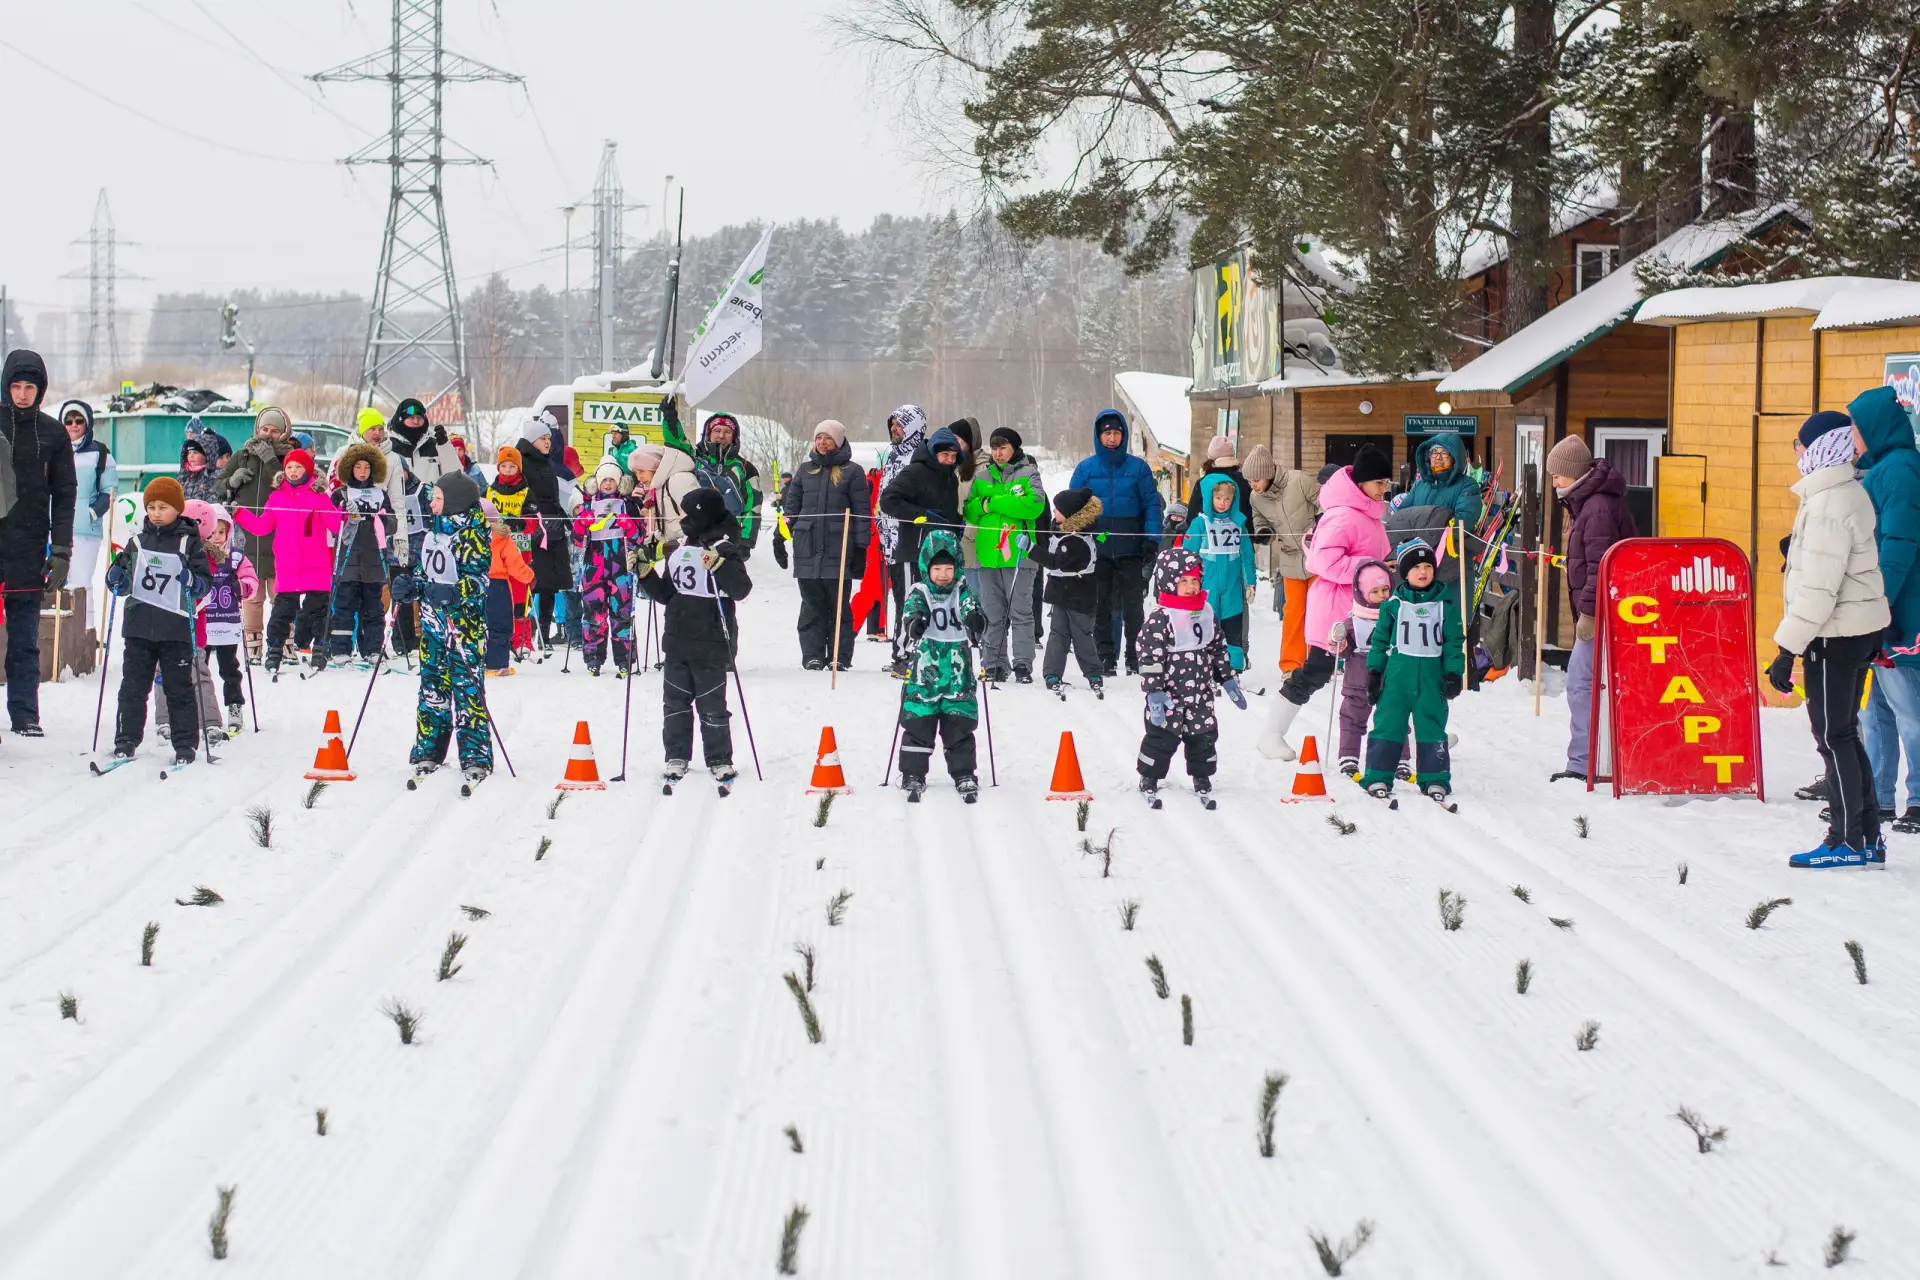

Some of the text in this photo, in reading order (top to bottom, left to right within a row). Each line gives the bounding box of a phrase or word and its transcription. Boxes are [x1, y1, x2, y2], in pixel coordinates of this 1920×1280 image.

[590, 404, 662, 423] ТУАЛЕТ
[1437, 418, 1474, 426] ПЛАТНЫЙ
[1209, 527, 1240, 547] 123
[425, 549, 446, 575] 70
[673, 565, 697, 590] 43
[206, 585, 232, 609] 26
[1193, 622, 1203, 645] 9
[1400, 620, 1444, 647] 110
[1617, 595, 1744, 784] СТАРТ
[1809, 855, 1861, 865] SPINE
